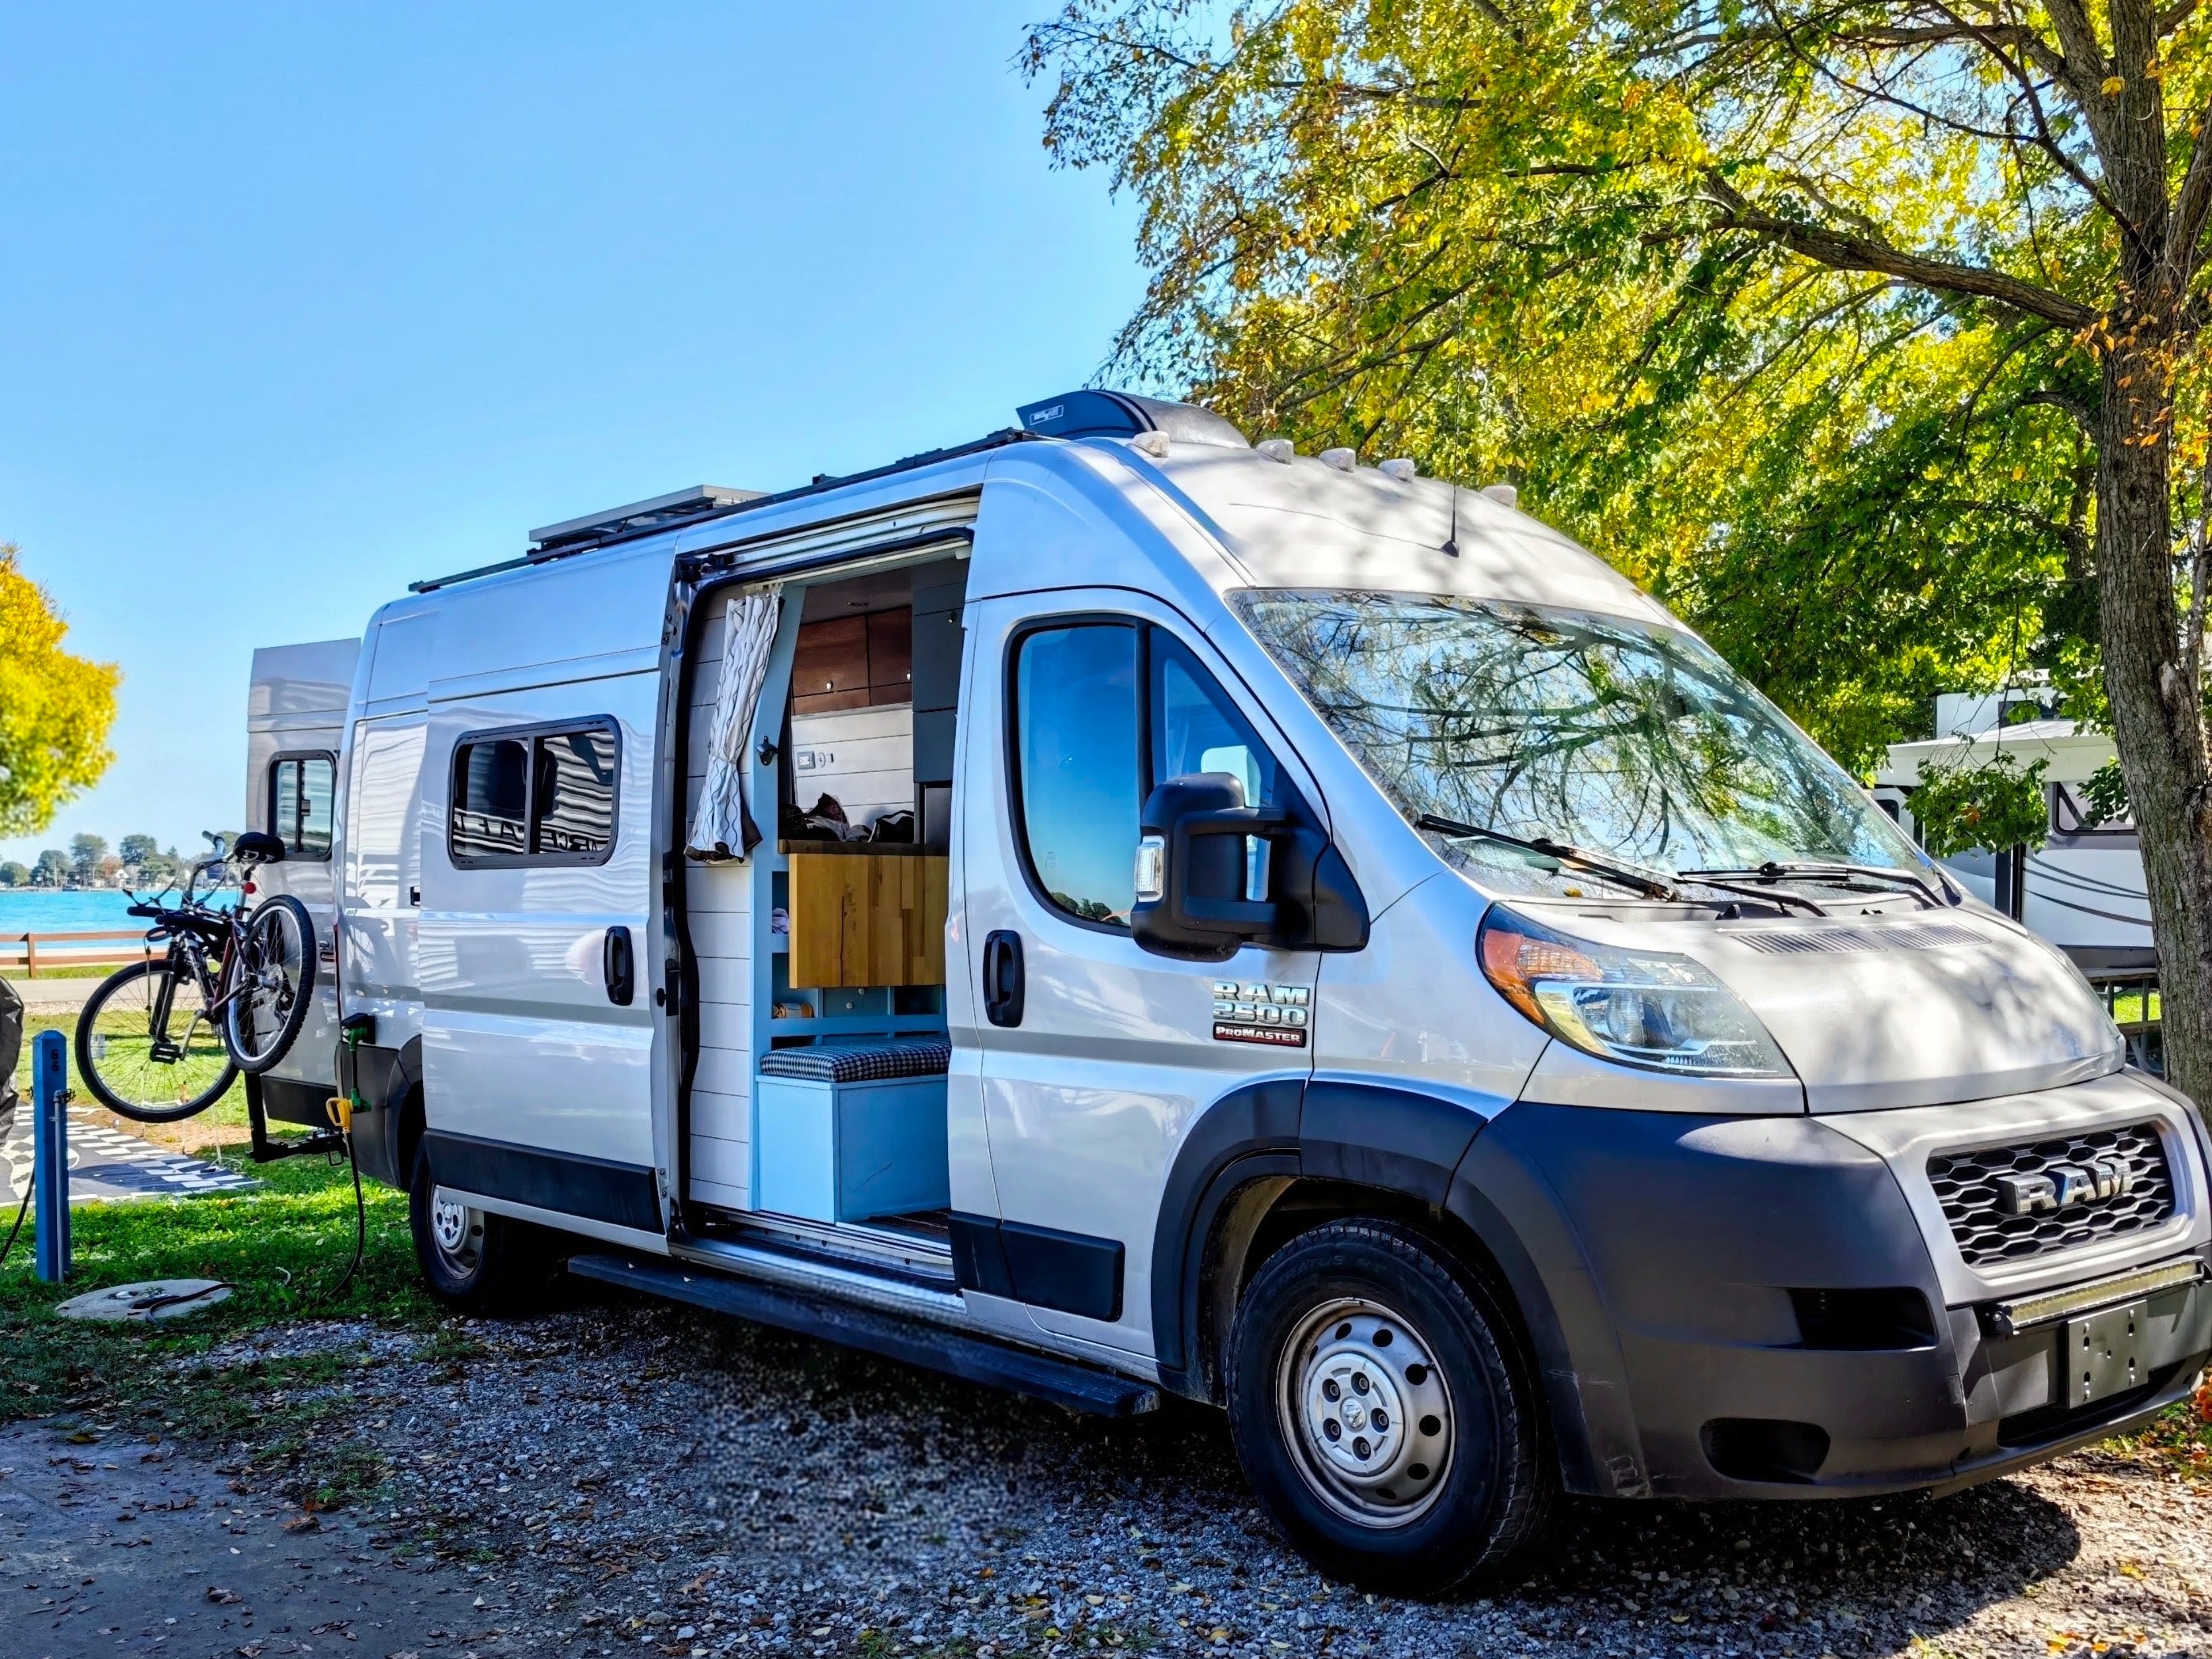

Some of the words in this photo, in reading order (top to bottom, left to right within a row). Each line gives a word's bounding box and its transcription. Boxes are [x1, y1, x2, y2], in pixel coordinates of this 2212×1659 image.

[1213, 981, 1310, 1006] RAM
[1213, 1001, 1308, 1027] 2500
[1997, 1157, 2132, 1213] RAM
